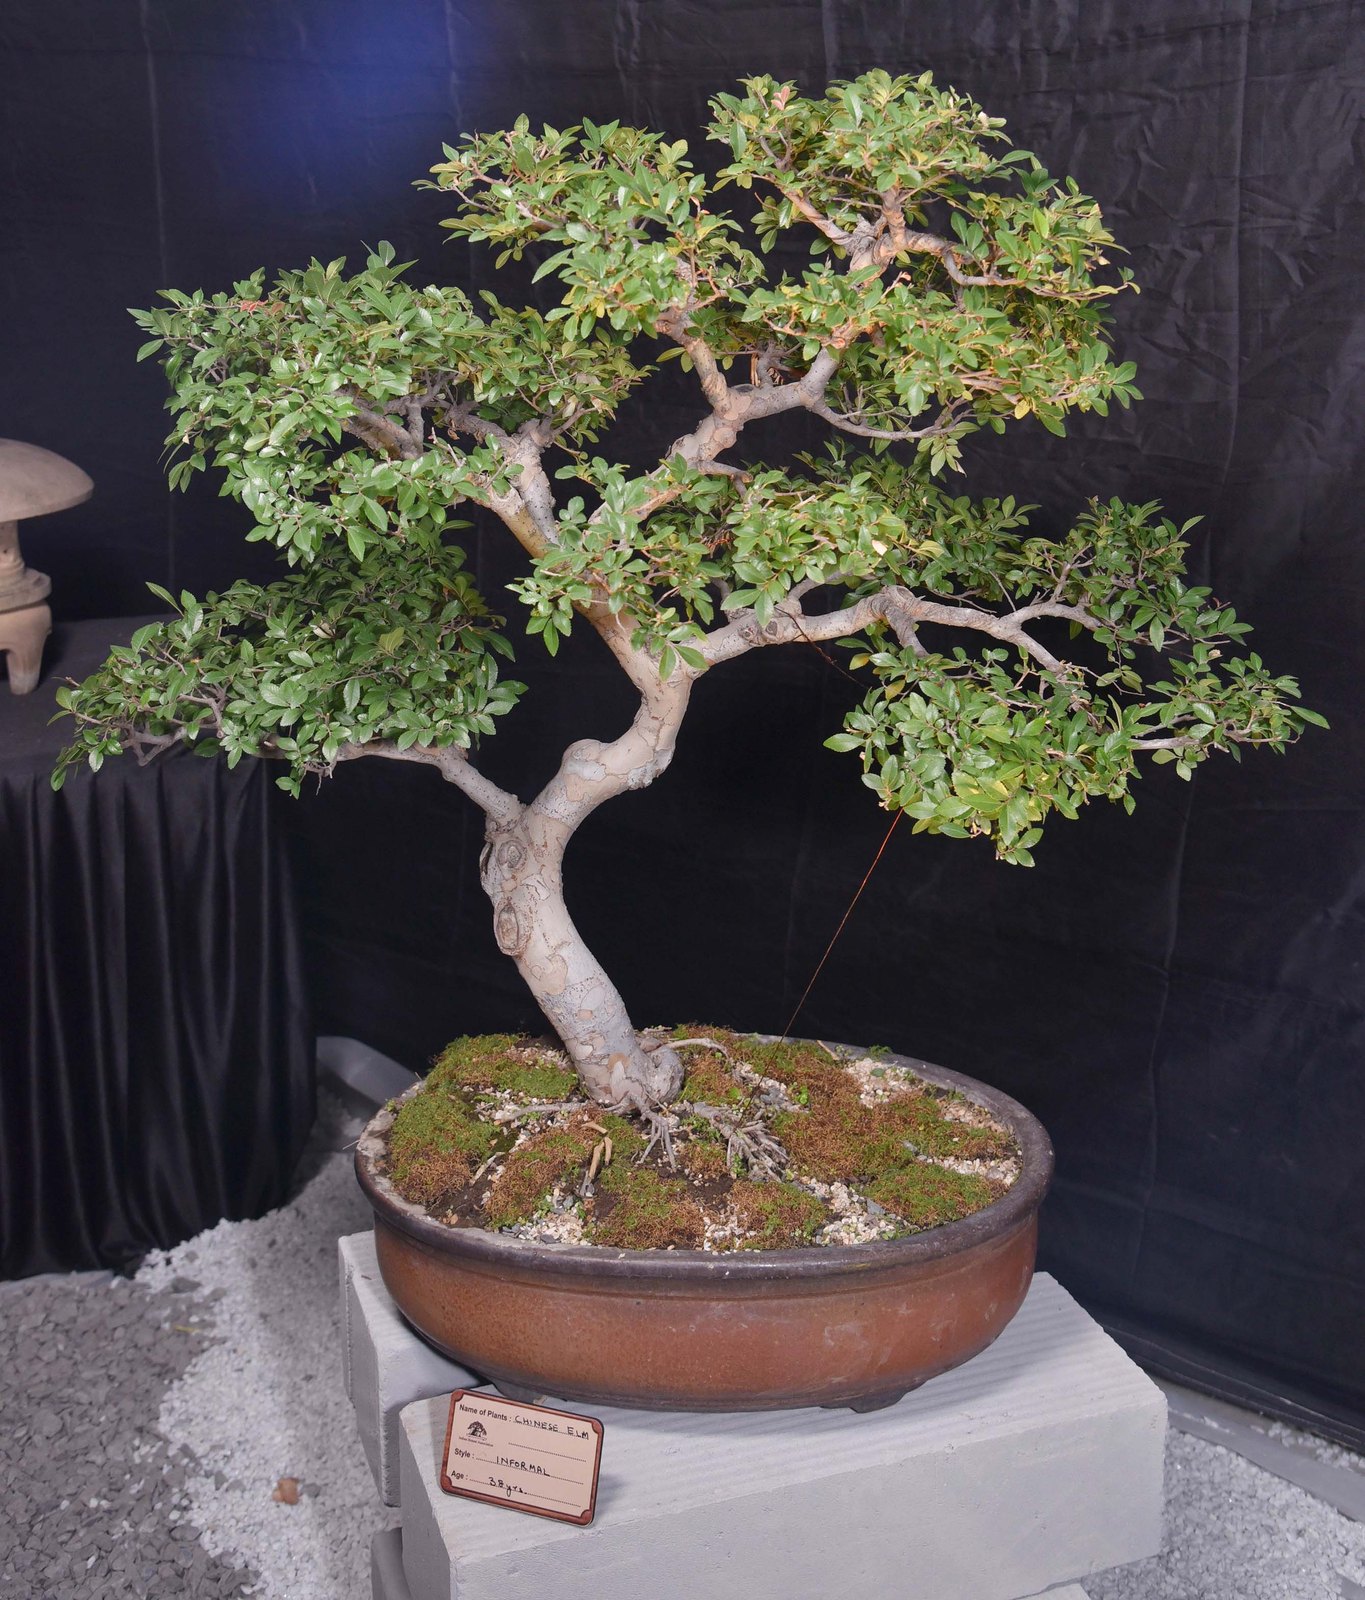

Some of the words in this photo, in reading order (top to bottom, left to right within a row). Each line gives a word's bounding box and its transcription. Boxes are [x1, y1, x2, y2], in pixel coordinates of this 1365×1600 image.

[459, 1404, 478, 1415] Name
[487, 1410, 508, 1422] Plants
[514, 1415, 559, 1433] CHINESE
[567, 1426, 590, 1441] ELM
[450, 1470, 465, 1480] Age
[454, 1447, 471, 1459] Style
[496, 1456, 551, 1477] INFORMAL
